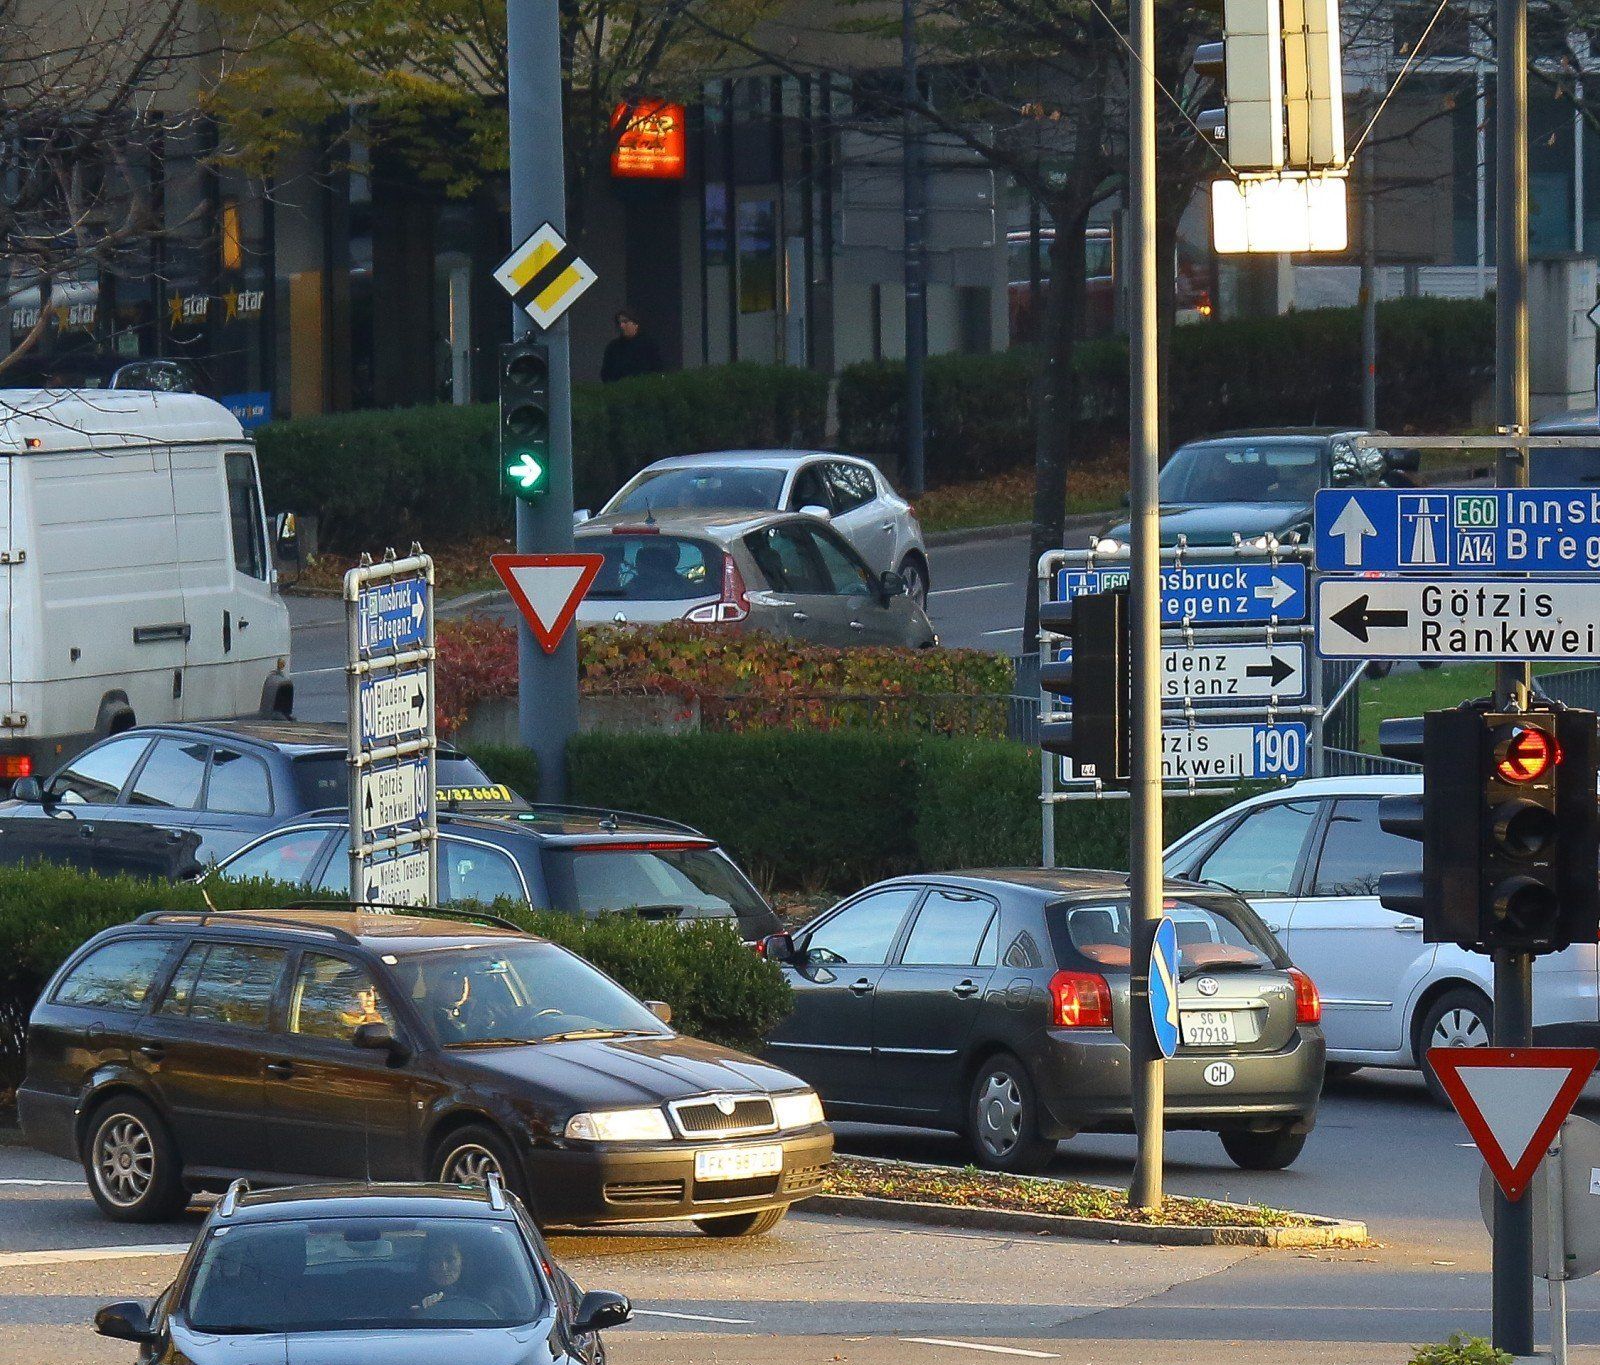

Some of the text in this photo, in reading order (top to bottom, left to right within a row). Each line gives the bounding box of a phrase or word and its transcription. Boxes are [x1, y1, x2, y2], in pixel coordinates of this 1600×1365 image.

[183, 294, 209, 315] star
[237, 290, 264, 312] star
[69, 302, 96, 324] star
[1457, 499, 1495, 525] E60
[1461, 536, 1492, 562] A14
[1162, 568, 1248, 590] nsbruck
[1169, 596, 1248, 619] egenz
[1421, 585, 1553, 617] Götzis
[378, 616, 412, 643] Bregenz
[1166, 652, 1227, 672] denz
[376, 685, 407, 709] Bludenz
[1167, 676, 1238, 695] stanz
[377, 709, 410, 735] Frastanz
[1162, 729, 1299, 773] tzis 190
[1162, 752, 1244, 777] nkweil
[378, 774, 403, 799] Götzis
[473, 787, 500, 800] 666
[378, 793, 413, 826] Rankweil
[1201, 1013, 1214, 1025] SG
[1190, 1027, 1229, 1043] 97918
[1211, 1065, 1228, 1082] CH
